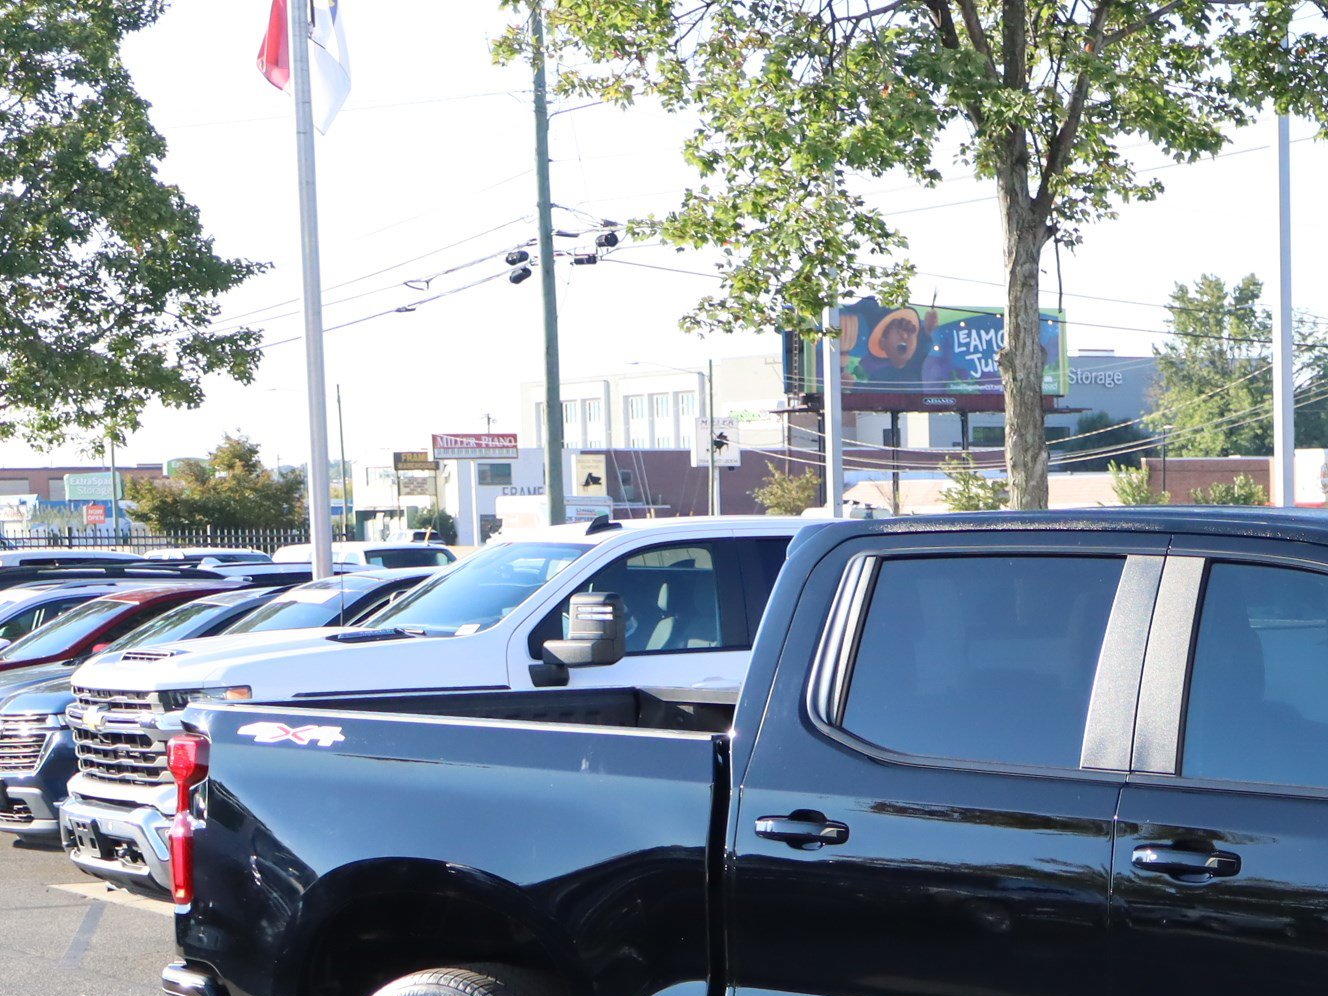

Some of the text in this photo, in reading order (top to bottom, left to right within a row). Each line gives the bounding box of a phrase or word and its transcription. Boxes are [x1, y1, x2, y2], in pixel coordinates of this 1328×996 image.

[1068, 367, 1123, 388] Storage
[437, 436, 515, 447] MILLER PIANO
